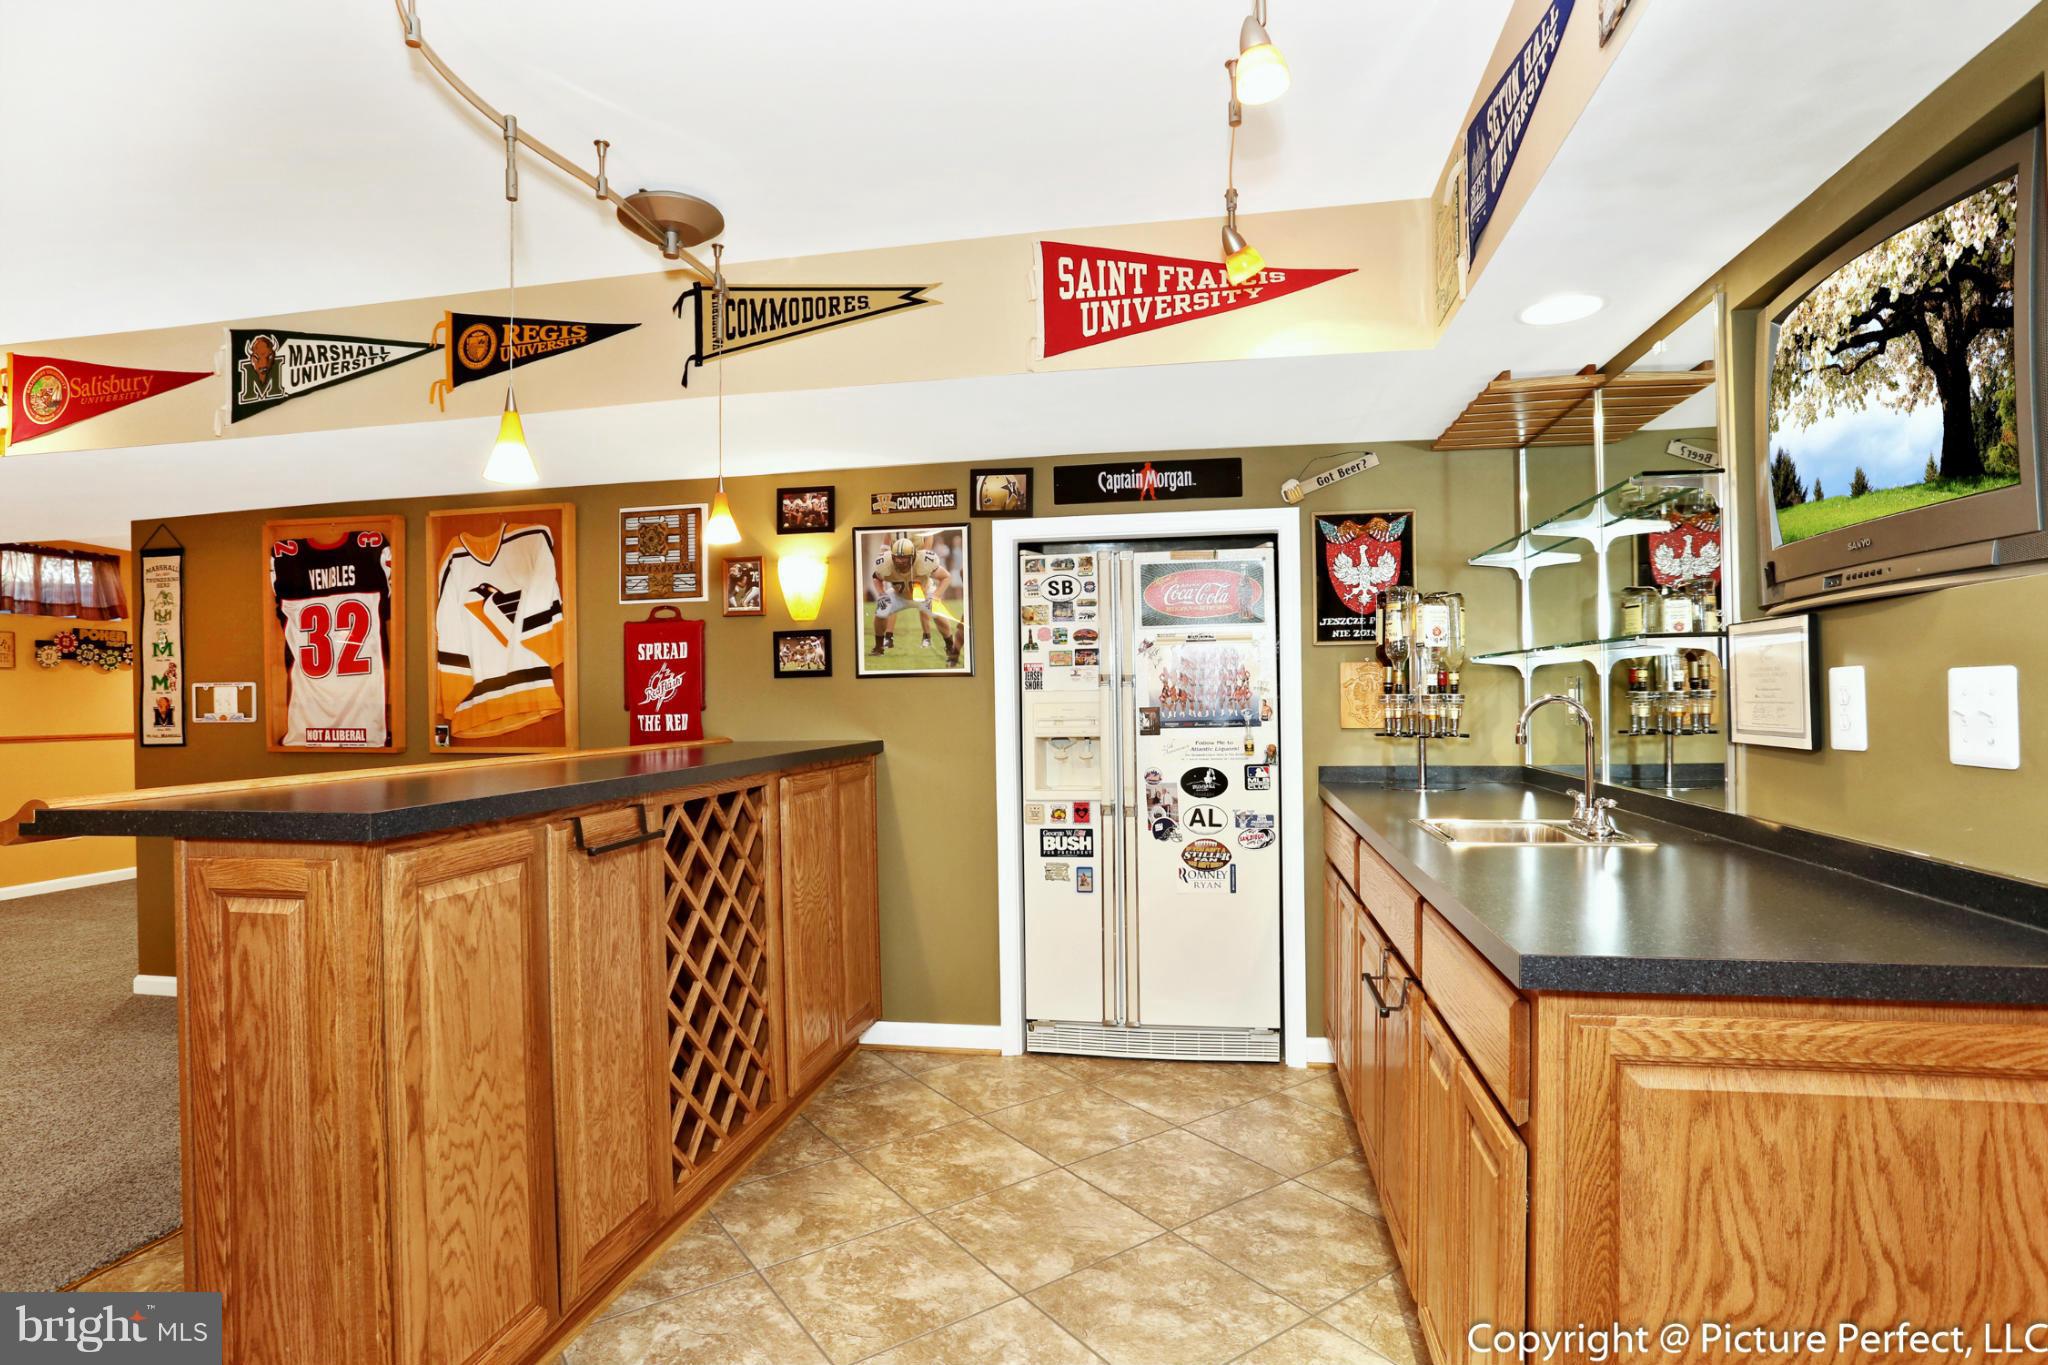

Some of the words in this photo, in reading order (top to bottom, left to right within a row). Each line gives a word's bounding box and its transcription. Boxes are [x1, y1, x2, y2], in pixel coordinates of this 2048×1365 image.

[1487, 60, 1520, 151] SETON
[1524, 4, 1559, 82] HALL
[1491, 23, 1559, 193] UNIVERSITY
[1057, 256, 1148, 300] SAINT
[1157, 265, 1286, 294] FRAIS
[725, 295, 870, 341] COMMODORES
[1080, 286, 1264, 338] UNIVERSITY
[502, 324, 588, 346] REGIS
[288, 344, 391, 368] MARSHALL
[500, 335, 588, 362] UNIVERSITY
[290, 354, 389, 387] UNIVERSITY
[70, 373, 154, 398] Salisbury
[80, 390, 146, 405] UNIVERSITY
[1097, 469, 1143, 494] Captain
[1143, 469, 1192, 492] Morgan
[1316, 472, 1335, 486] Got
[1337, 458, 1367, 479] Beer?
[896, 493, 955, 510] COMMODORES
[1847, 537, 1871, 551] SANYO
[1047, 580, 1074, 596] SB
[1164, 582, 1231, 606] Coca-Cola
[1320, 616, 1367, 626] JESZCZE
[299, 598, 372, 679] 32
[1331, 629, 1352, 638] NIE
[637, 641, 688, 661] SPREAD
[1024, 671, 1043, 681] JERSEY
[1024, 680, 1043, 690] SHORE
[637, 714, 661, 732] THE
[665, 713, 689, 732] RED
[306, 729, 323, 741] NOT
[324, 729, 331, 741] A
[331, 729, 366, 741] LIBERAL
[1189, 807, 1223, 828] AL
[1042, 836, 1092, 851] BUSH
[1183, 851, 1231, 861] STILLER
[1178, 867, 1228, 884] ROMNEY
[1193, 881, 1222, 889] RYAN
